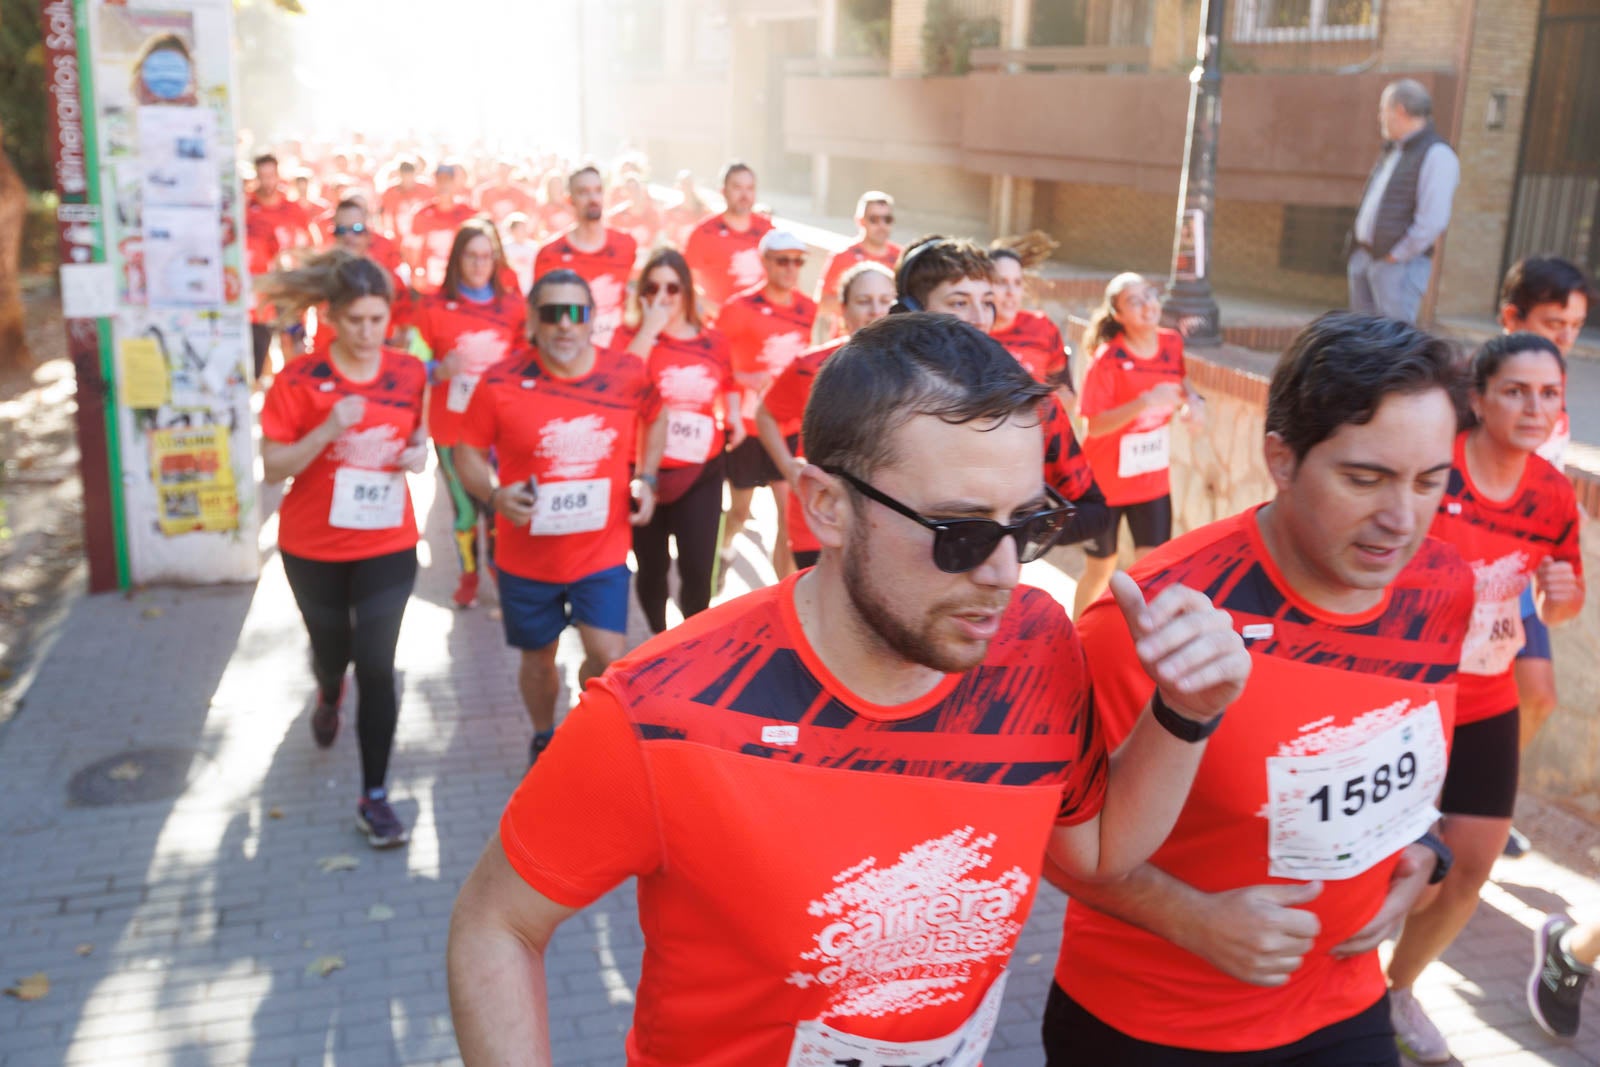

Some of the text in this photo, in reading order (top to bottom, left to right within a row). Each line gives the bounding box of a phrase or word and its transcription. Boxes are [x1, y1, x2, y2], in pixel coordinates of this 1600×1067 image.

[354, 484, 391, 501] 867
[551, 493, 587, 512] 868
[1308, 751, 1416, 822] 1589
[818, 887, 1011, 958] carrera
